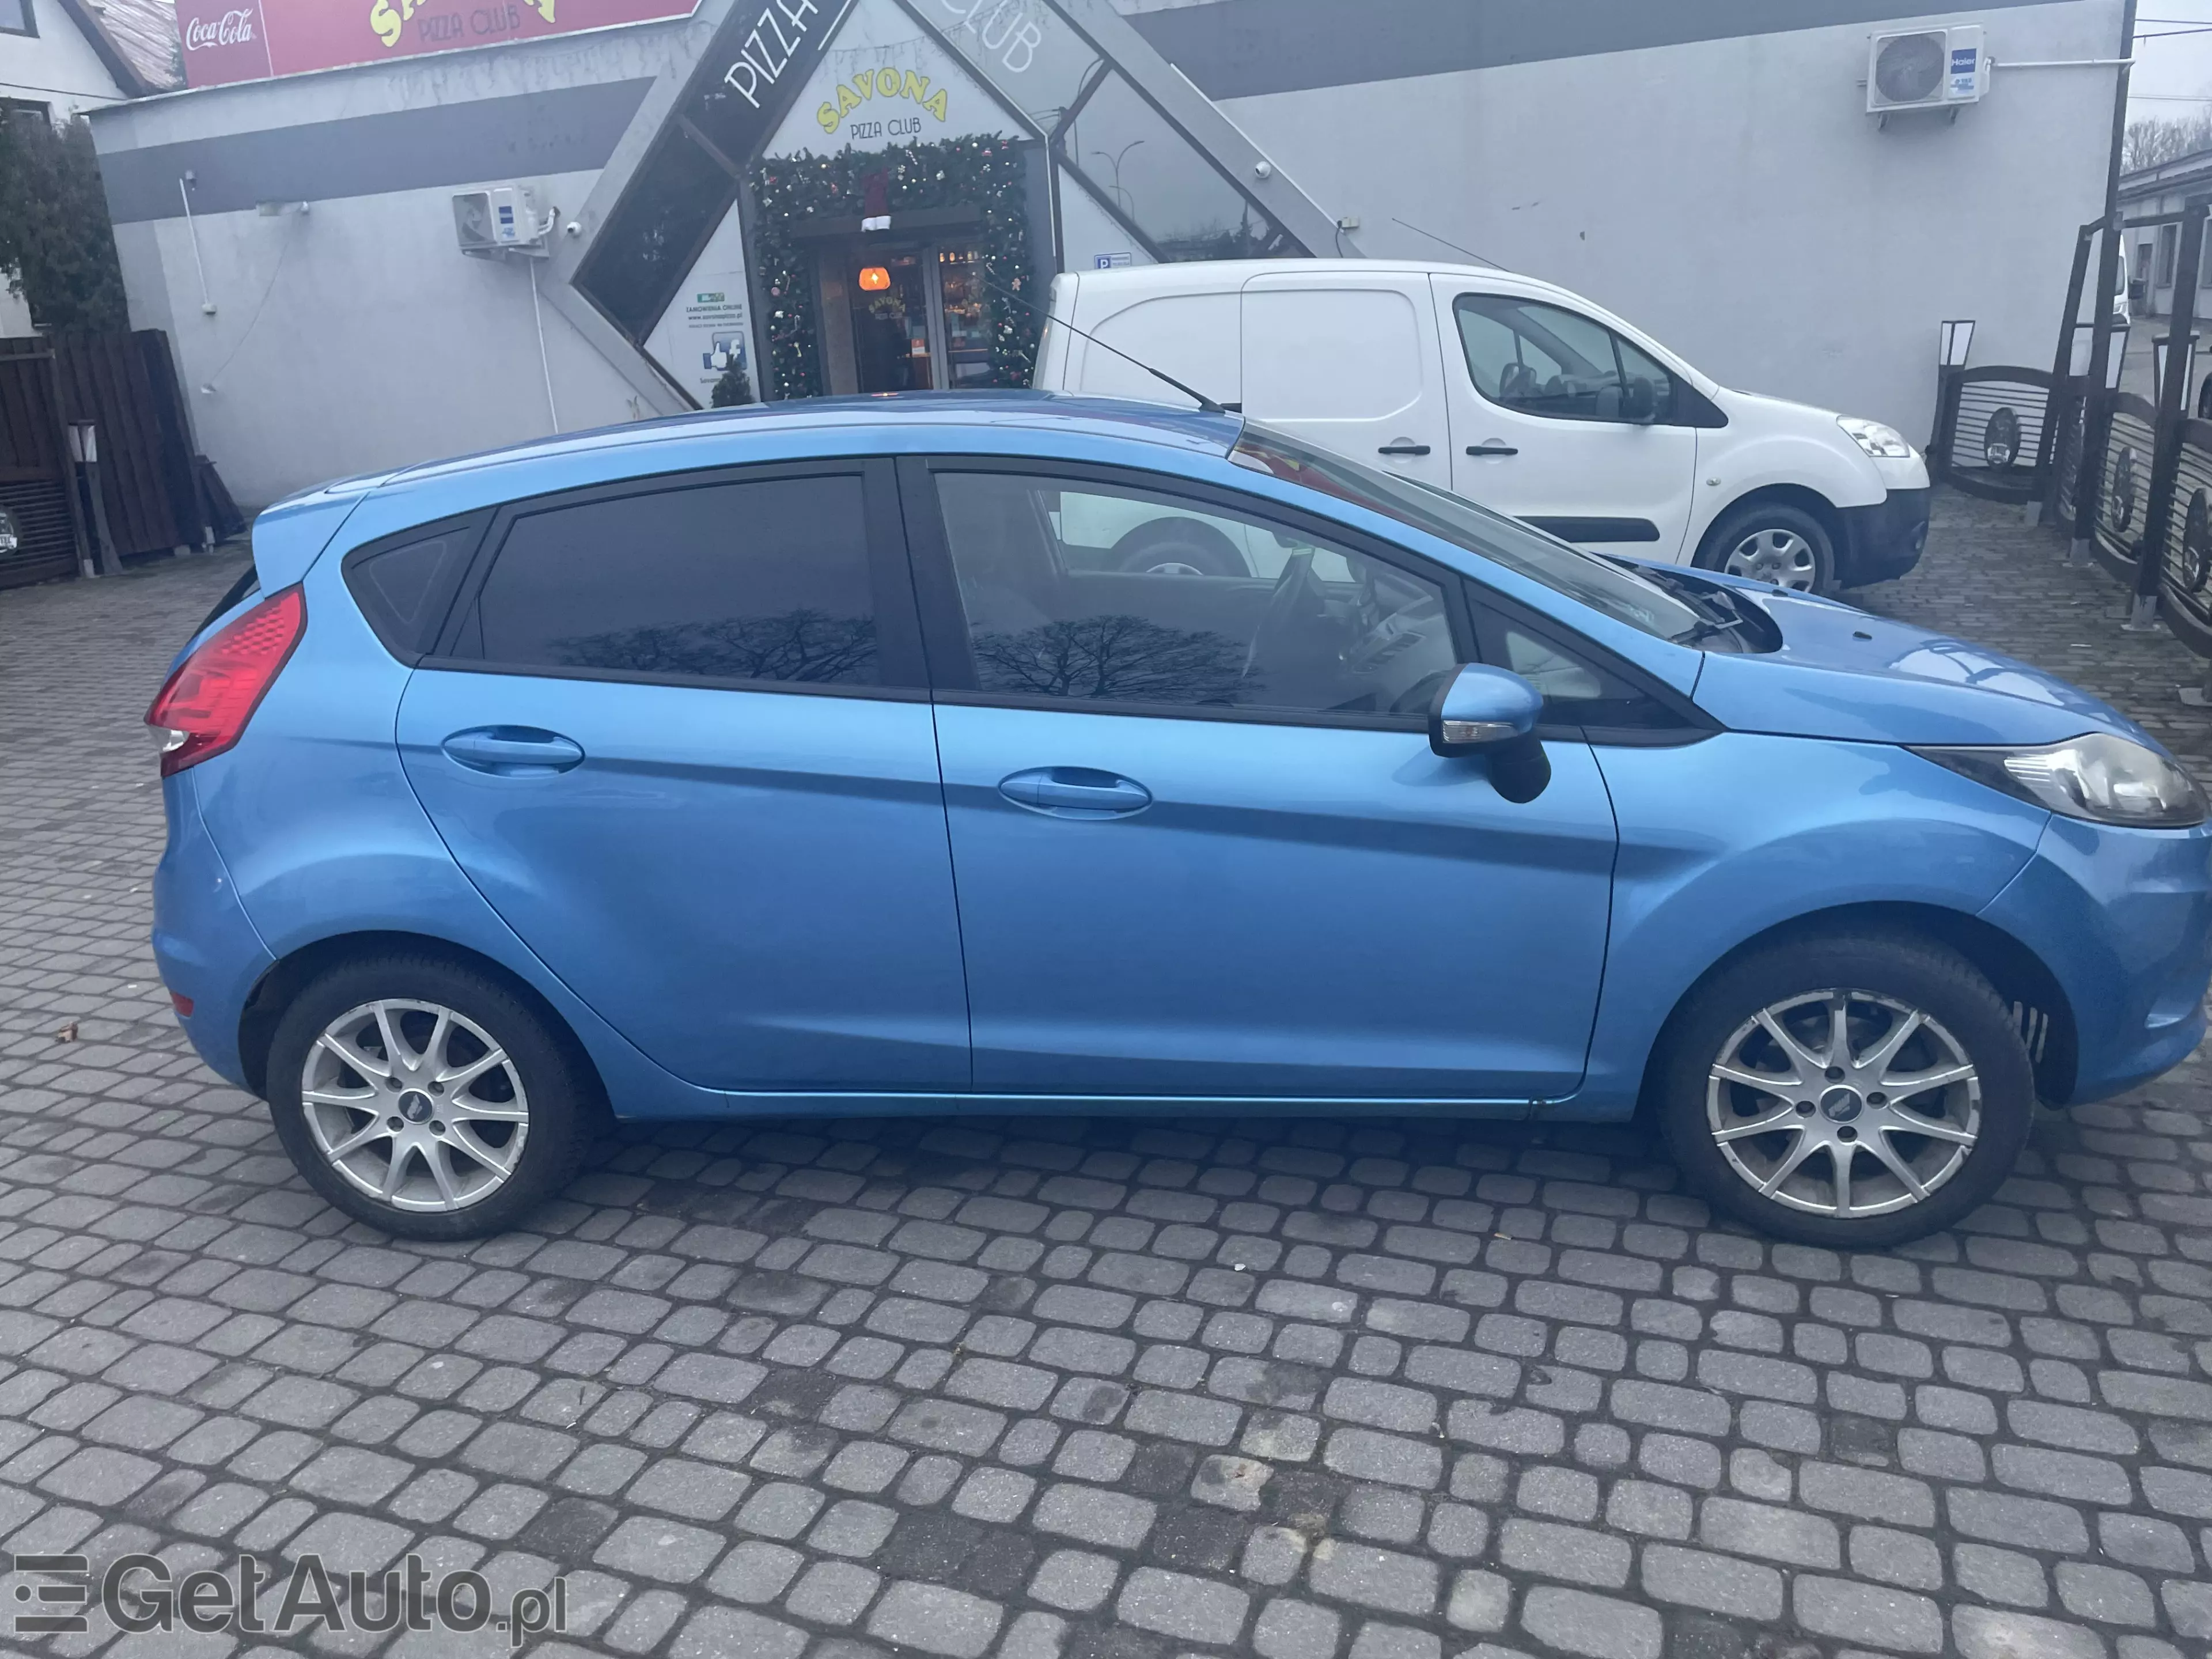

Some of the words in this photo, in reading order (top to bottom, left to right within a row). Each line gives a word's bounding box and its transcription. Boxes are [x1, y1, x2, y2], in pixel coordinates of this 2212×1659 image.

[186, 9, 253, 51] Coca-Cola
[418, 13, 464, 43] PIZZA
[470, 5, 520, 35] CLUB
[1951, 58, 1975, 66] Haier
[817, 67, 948, 134] SAVONA
[850, 122, 882, 140] PIZZA
[888, 117, 922, 136] CLUB
[1100, 259, 1109, 269] P
